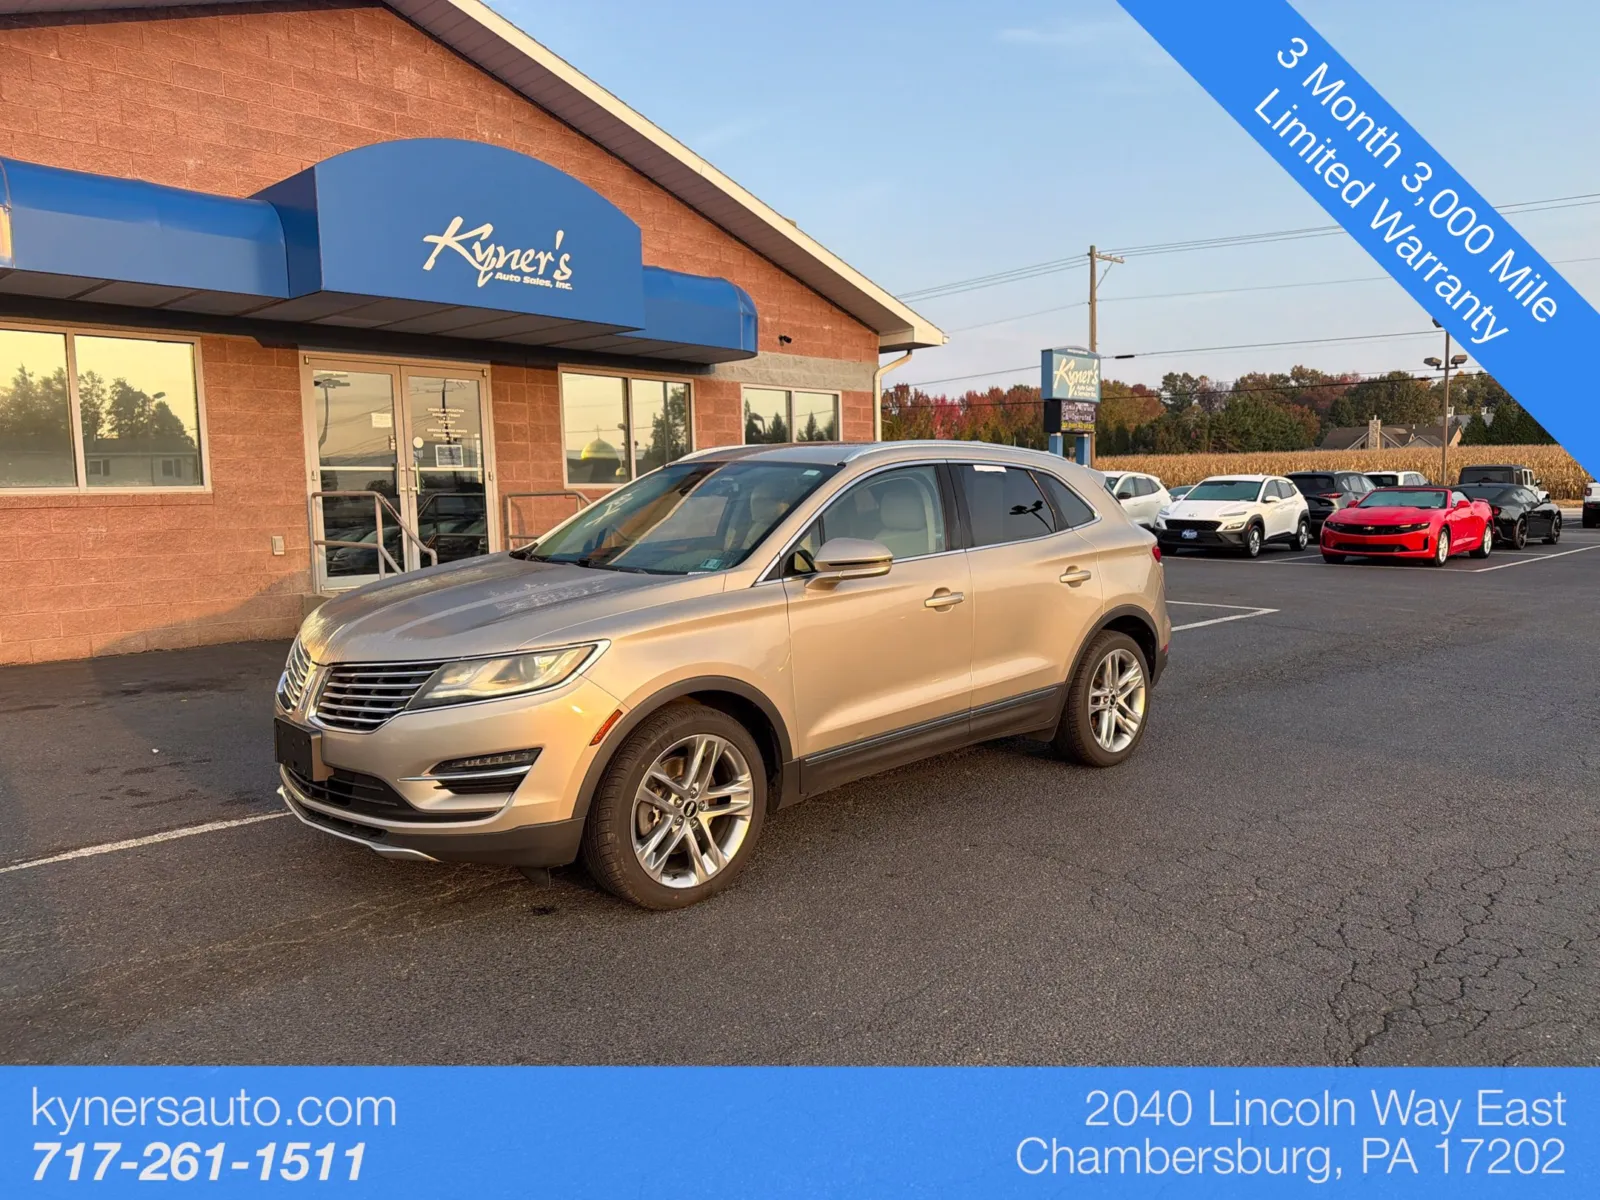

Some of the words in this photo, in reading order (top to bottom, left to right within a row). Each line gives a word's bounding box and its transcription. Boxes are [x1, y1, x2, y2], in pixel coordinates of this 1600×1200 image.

[422, 216, 573, 288] Kyner's
[495, 271, 521, 283] Auto
[523, 275, 553, 288] Sales,
[555, 280, 573, 290] Inc.
[1053, 357, 1099, 398] Kyner's
